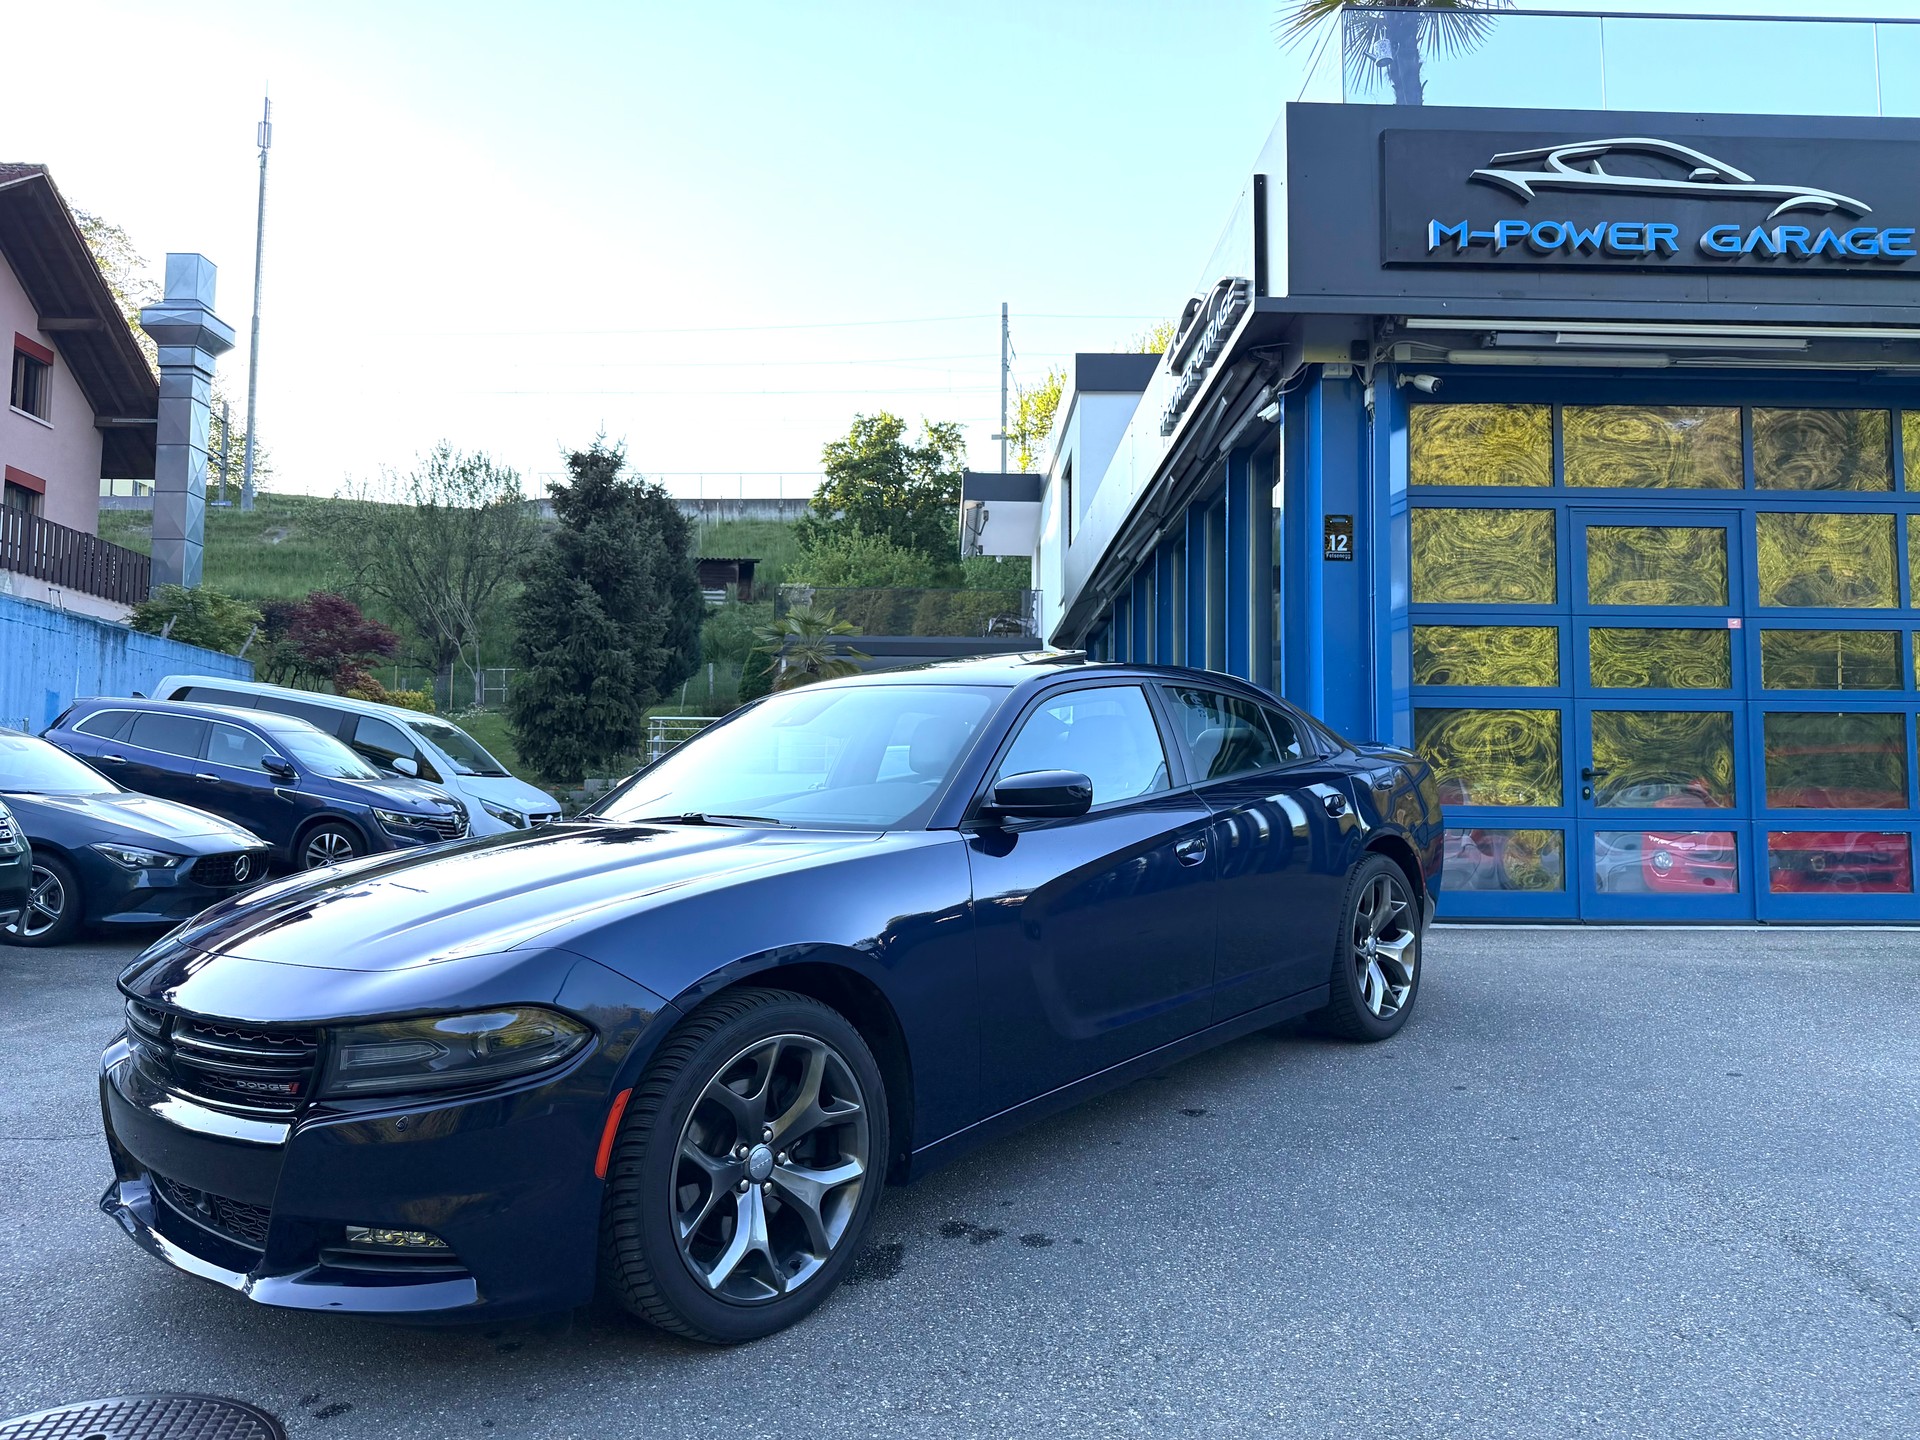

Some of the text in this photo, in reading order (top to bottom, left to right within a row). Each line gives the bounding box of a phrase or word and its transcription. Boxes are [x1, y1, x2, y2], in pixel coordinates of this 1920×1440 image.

[1429, 219, 1918, 257] M-POWER GARAGE
[1330, 534, 1347, 551] 12
[236, 1080, 291, 1091] DODGE
